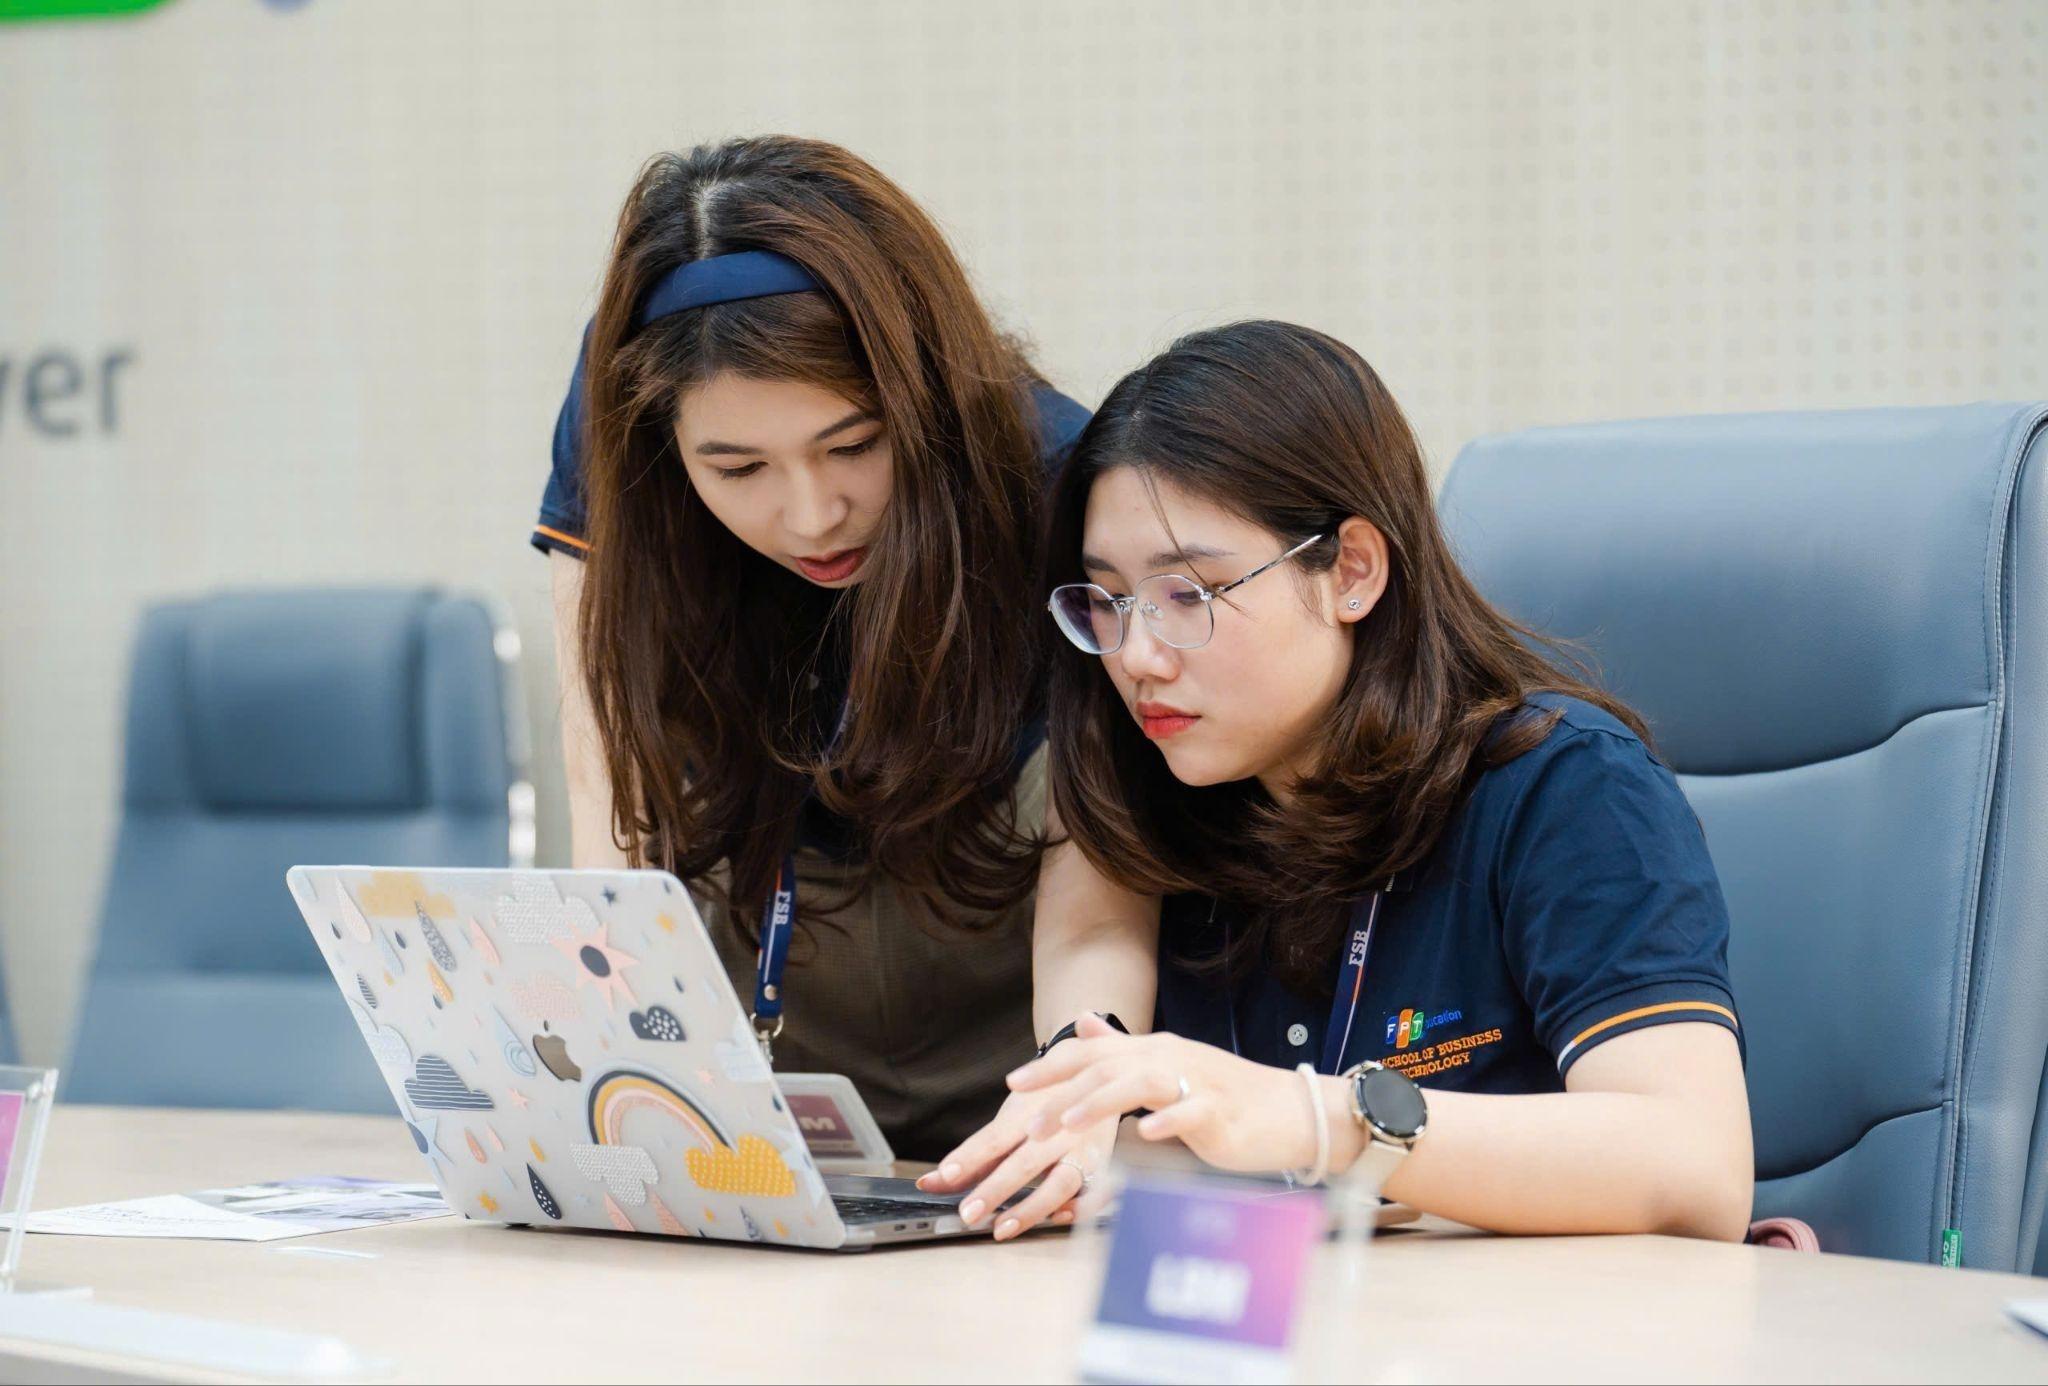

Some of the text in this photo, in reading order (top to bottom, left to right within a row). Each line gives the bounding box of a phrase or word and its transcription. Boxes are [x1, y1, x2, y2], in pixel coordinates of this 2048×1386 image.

[775, 891, 791, 925] FSB
[1349, 930, 1368, 966] FSB
[1422, 1047, 1435, 1061] OF
[1437, 1028, 1502, 1056] BUSINESS
